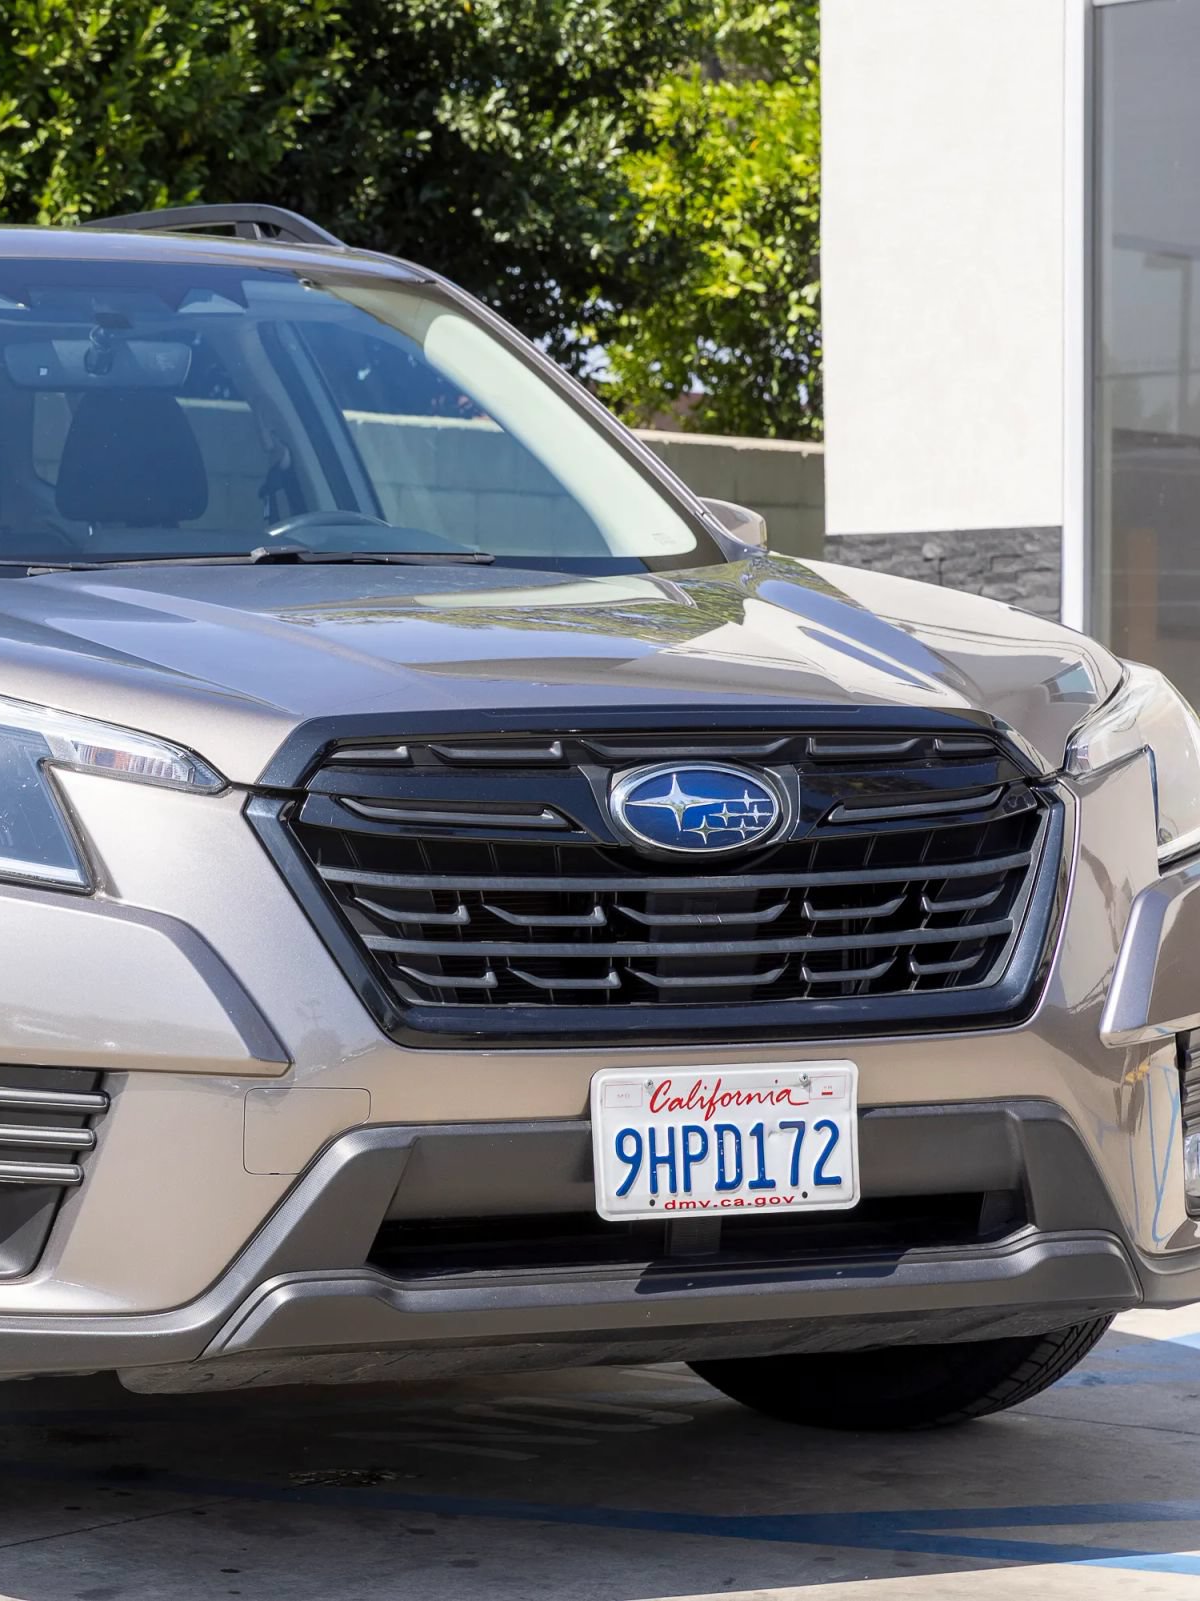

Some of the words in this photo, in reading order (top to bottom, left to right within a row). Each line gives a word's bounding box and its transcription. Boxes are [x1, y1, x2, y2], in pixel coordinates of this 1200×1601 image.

[649, 1078, 808, 1121] California
[615, 1119, 841, 1197] 9HPD172
[664, 1195, 795, 1210] dmv.ca.gov
